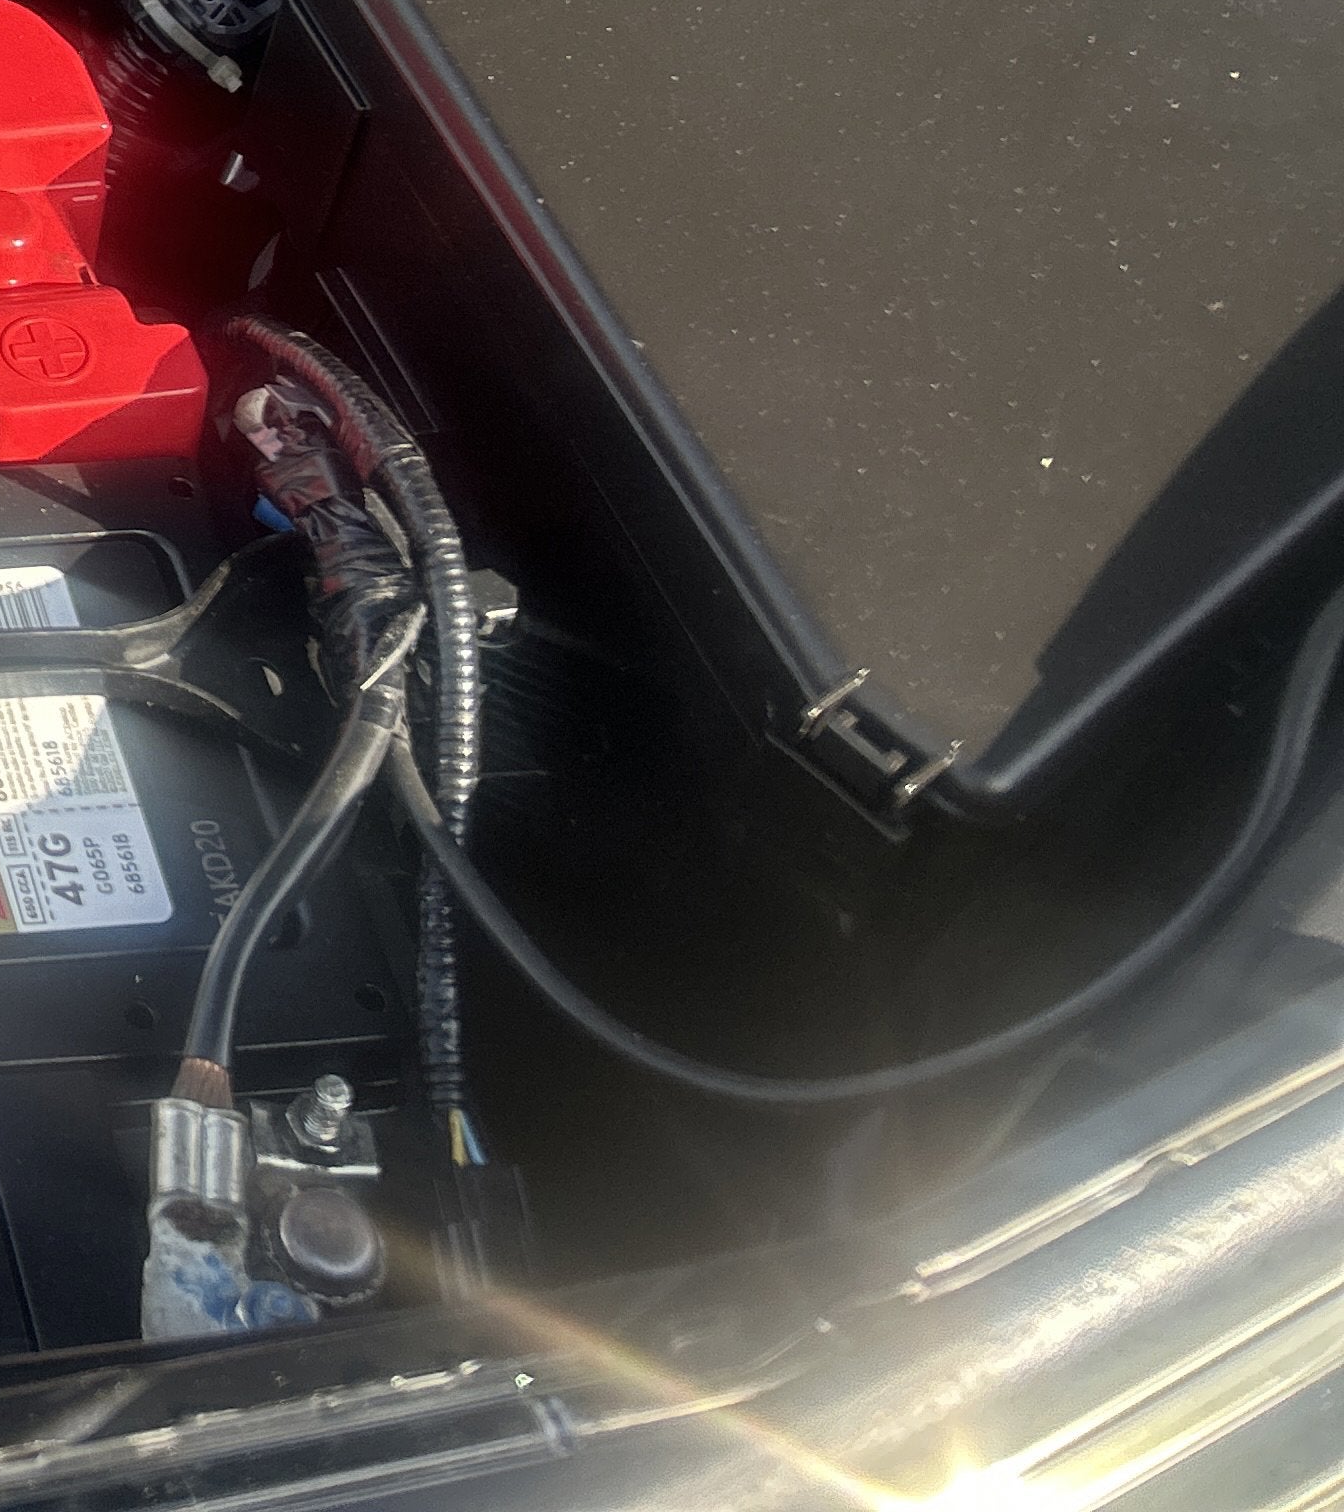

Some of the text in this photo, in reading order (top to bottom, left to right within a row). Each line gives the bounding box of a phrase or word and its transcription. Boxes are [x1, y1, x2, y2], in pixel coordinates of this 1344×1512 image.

[40, 739, 74, 797] 685618
[14, 869, 38, 918] 650 CCA
[34, 831, 88, 907] 47G
[110, 832, 144, 895] 685618
